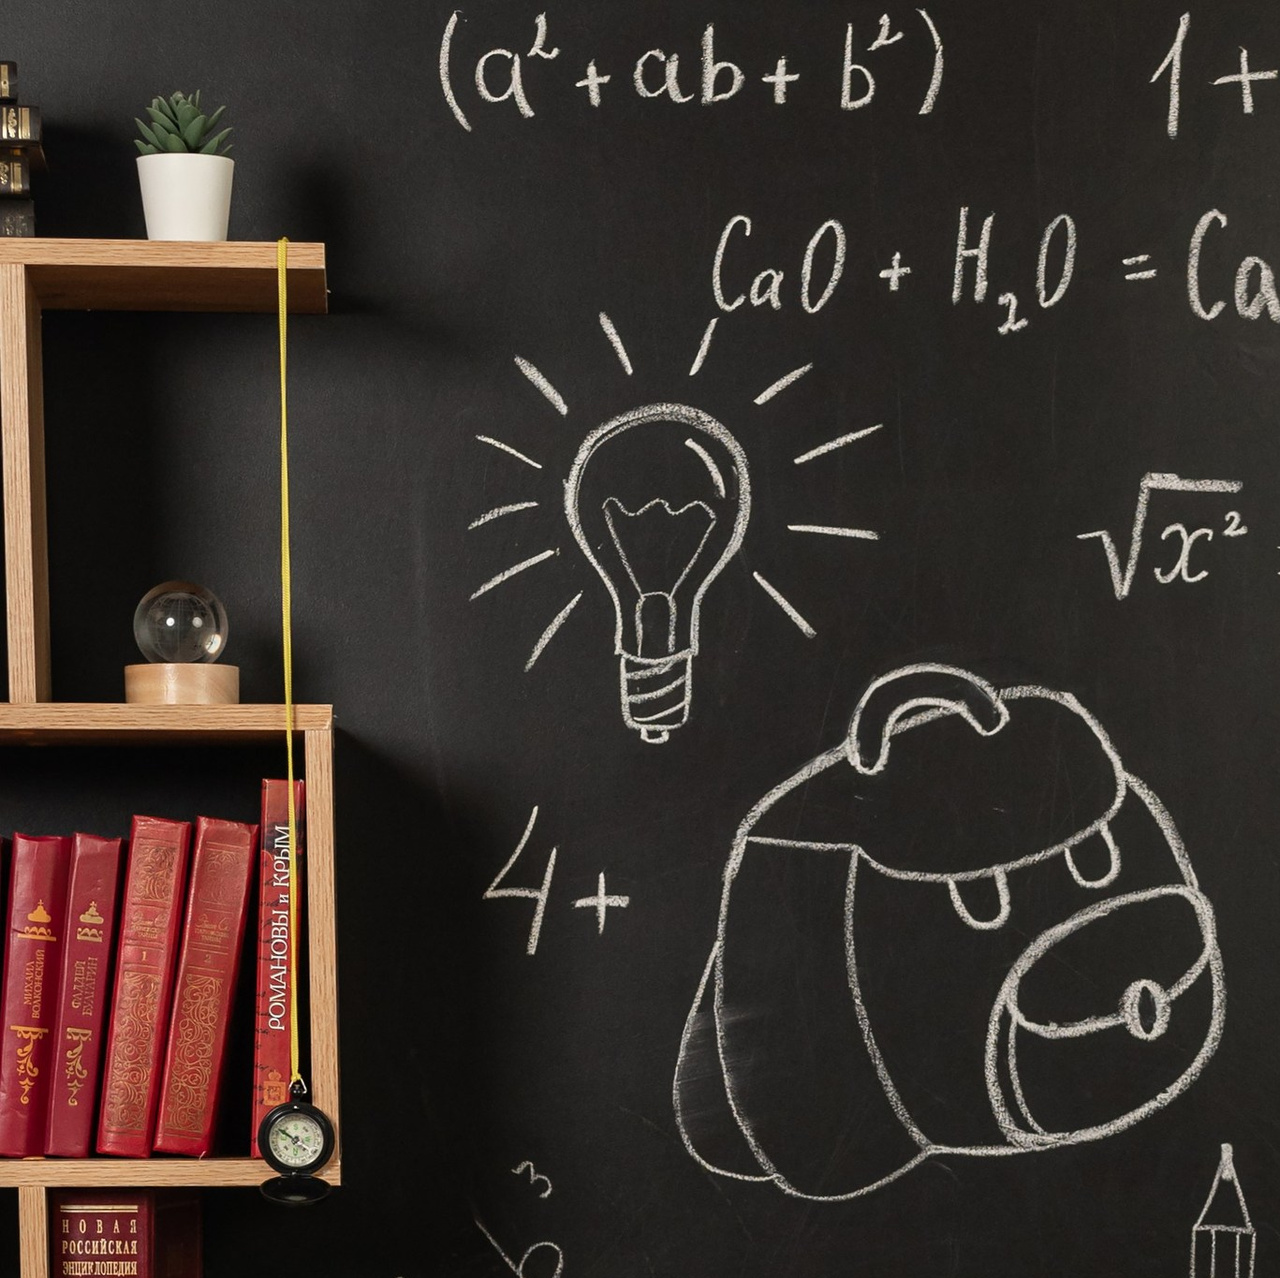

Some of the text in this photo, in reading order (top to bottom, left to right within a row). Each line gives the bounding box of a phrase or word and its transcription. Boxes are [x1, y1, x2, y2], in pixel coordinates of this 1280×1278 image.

[273, 825, 291, 887] КРЫМ
[23, 960, 35, 1005] МИХАИЛ
[31, 949, 45, 1019] ВОЛКОНСКИЙ
[71, 960, 85, 1009] ФАДДЕЙ
[82, 956, 98, 1016] БУЛГАРИН
[267, 911, 291, 1032] РОМАНОВЫ
[61, 1237, 138, 1256] РОССИЙСКАЯ
[62, 1218, 138, 1234] НОВАЯ
[62, 1261, 138, 1277] ЭНЦИКЛОПЕДИЯ
